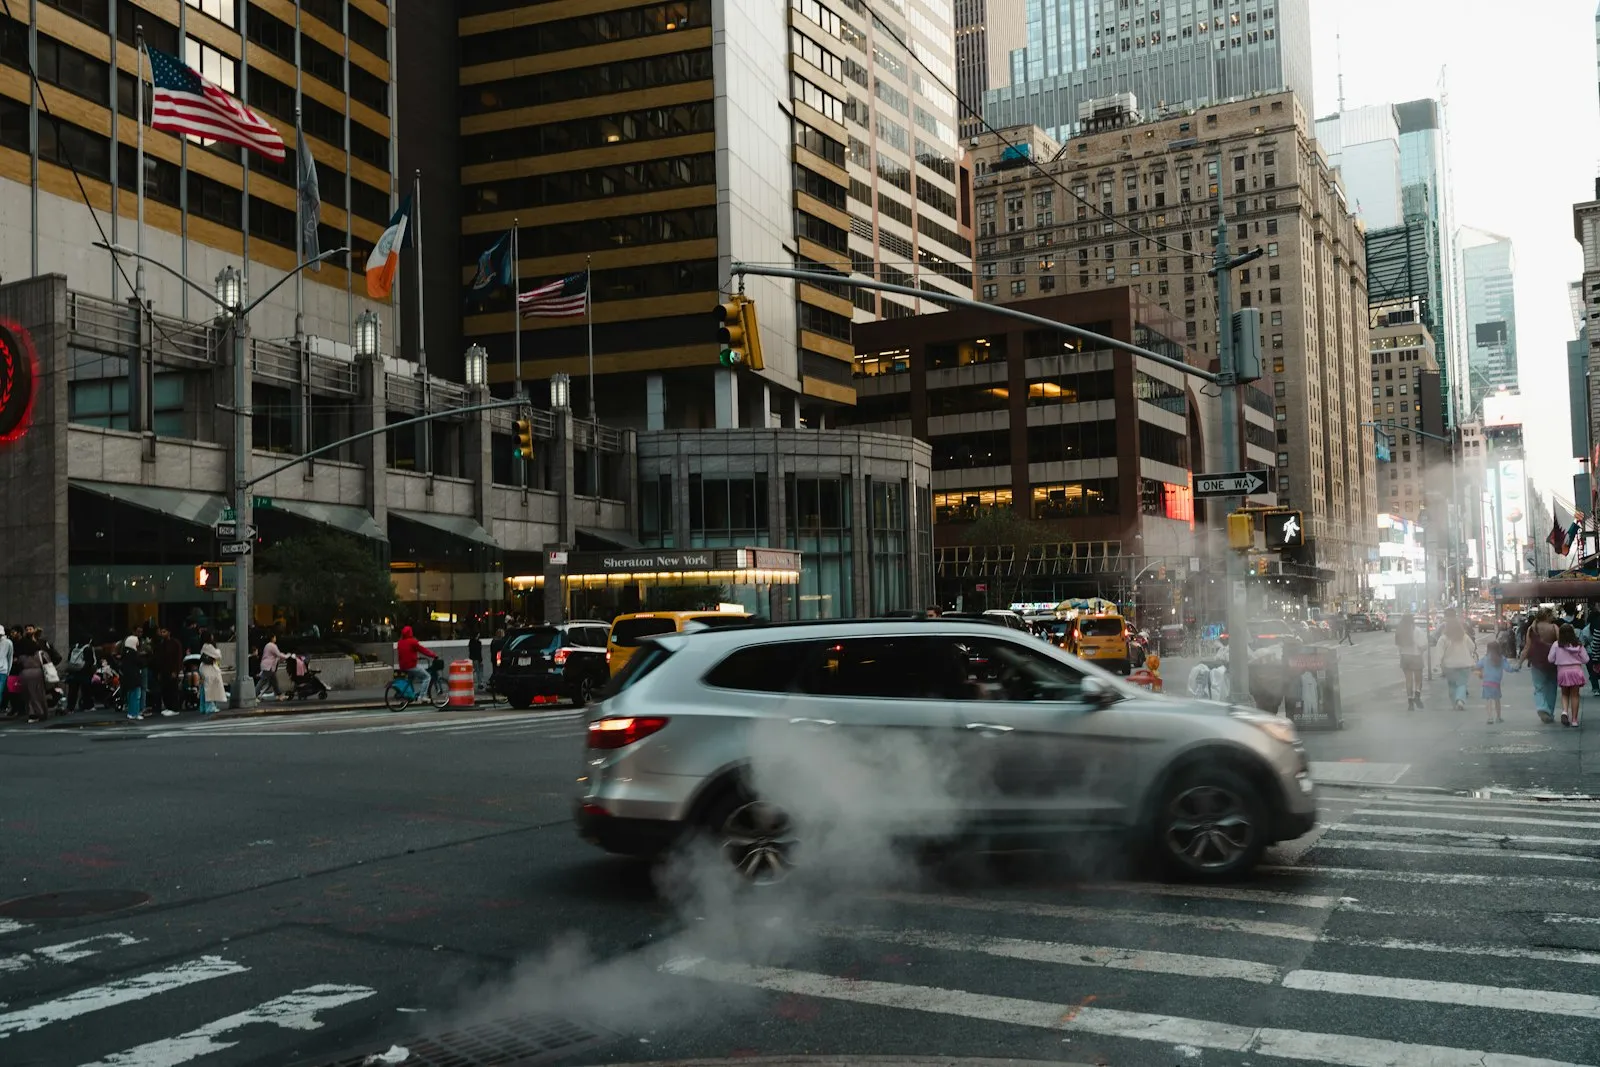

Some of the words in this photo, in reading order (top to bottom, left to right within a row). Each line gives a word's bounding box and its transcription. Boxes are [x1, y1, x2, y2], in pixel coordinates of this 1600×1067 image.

[1203, 481, 1225, 491] ONE
[1234, 478, 1256, 489] WAY
[257, 498, 261, 507] 7
[604, 557, 653, 568] Sheraton
[657, 556, 680, 566] New
[684, 555, 708, 565] York
